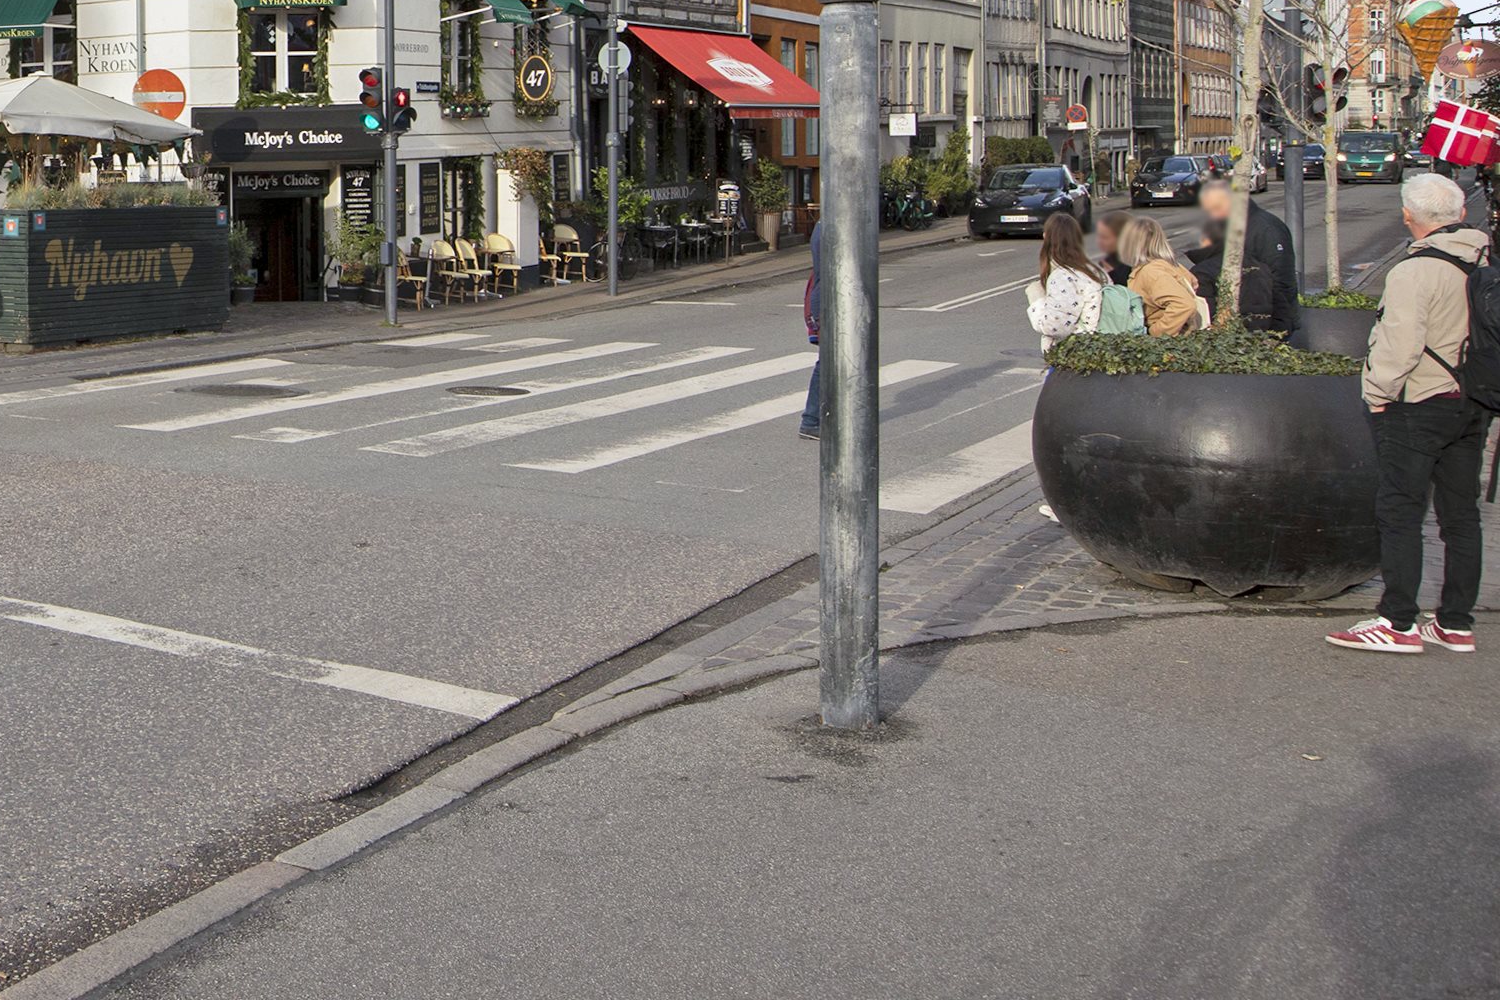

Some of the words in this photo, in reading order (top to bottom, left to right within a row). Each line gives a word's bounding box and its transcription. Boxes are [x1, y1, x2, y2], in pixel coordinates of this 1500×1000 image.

[88, 57, 137, 73] KROEN
[526, 70, 545, 87] 47
[591, 71, 618, 85] BA
[244, 130, 293, 149] McJoy's
[299, 129, 343, 144] Choice
[237, 175, 278, 190] McJoy's
[283, 173, 320, 186] Choice
[352, 178, 364, 187] 47
[45, 238, 165, 301] Nyhavn
